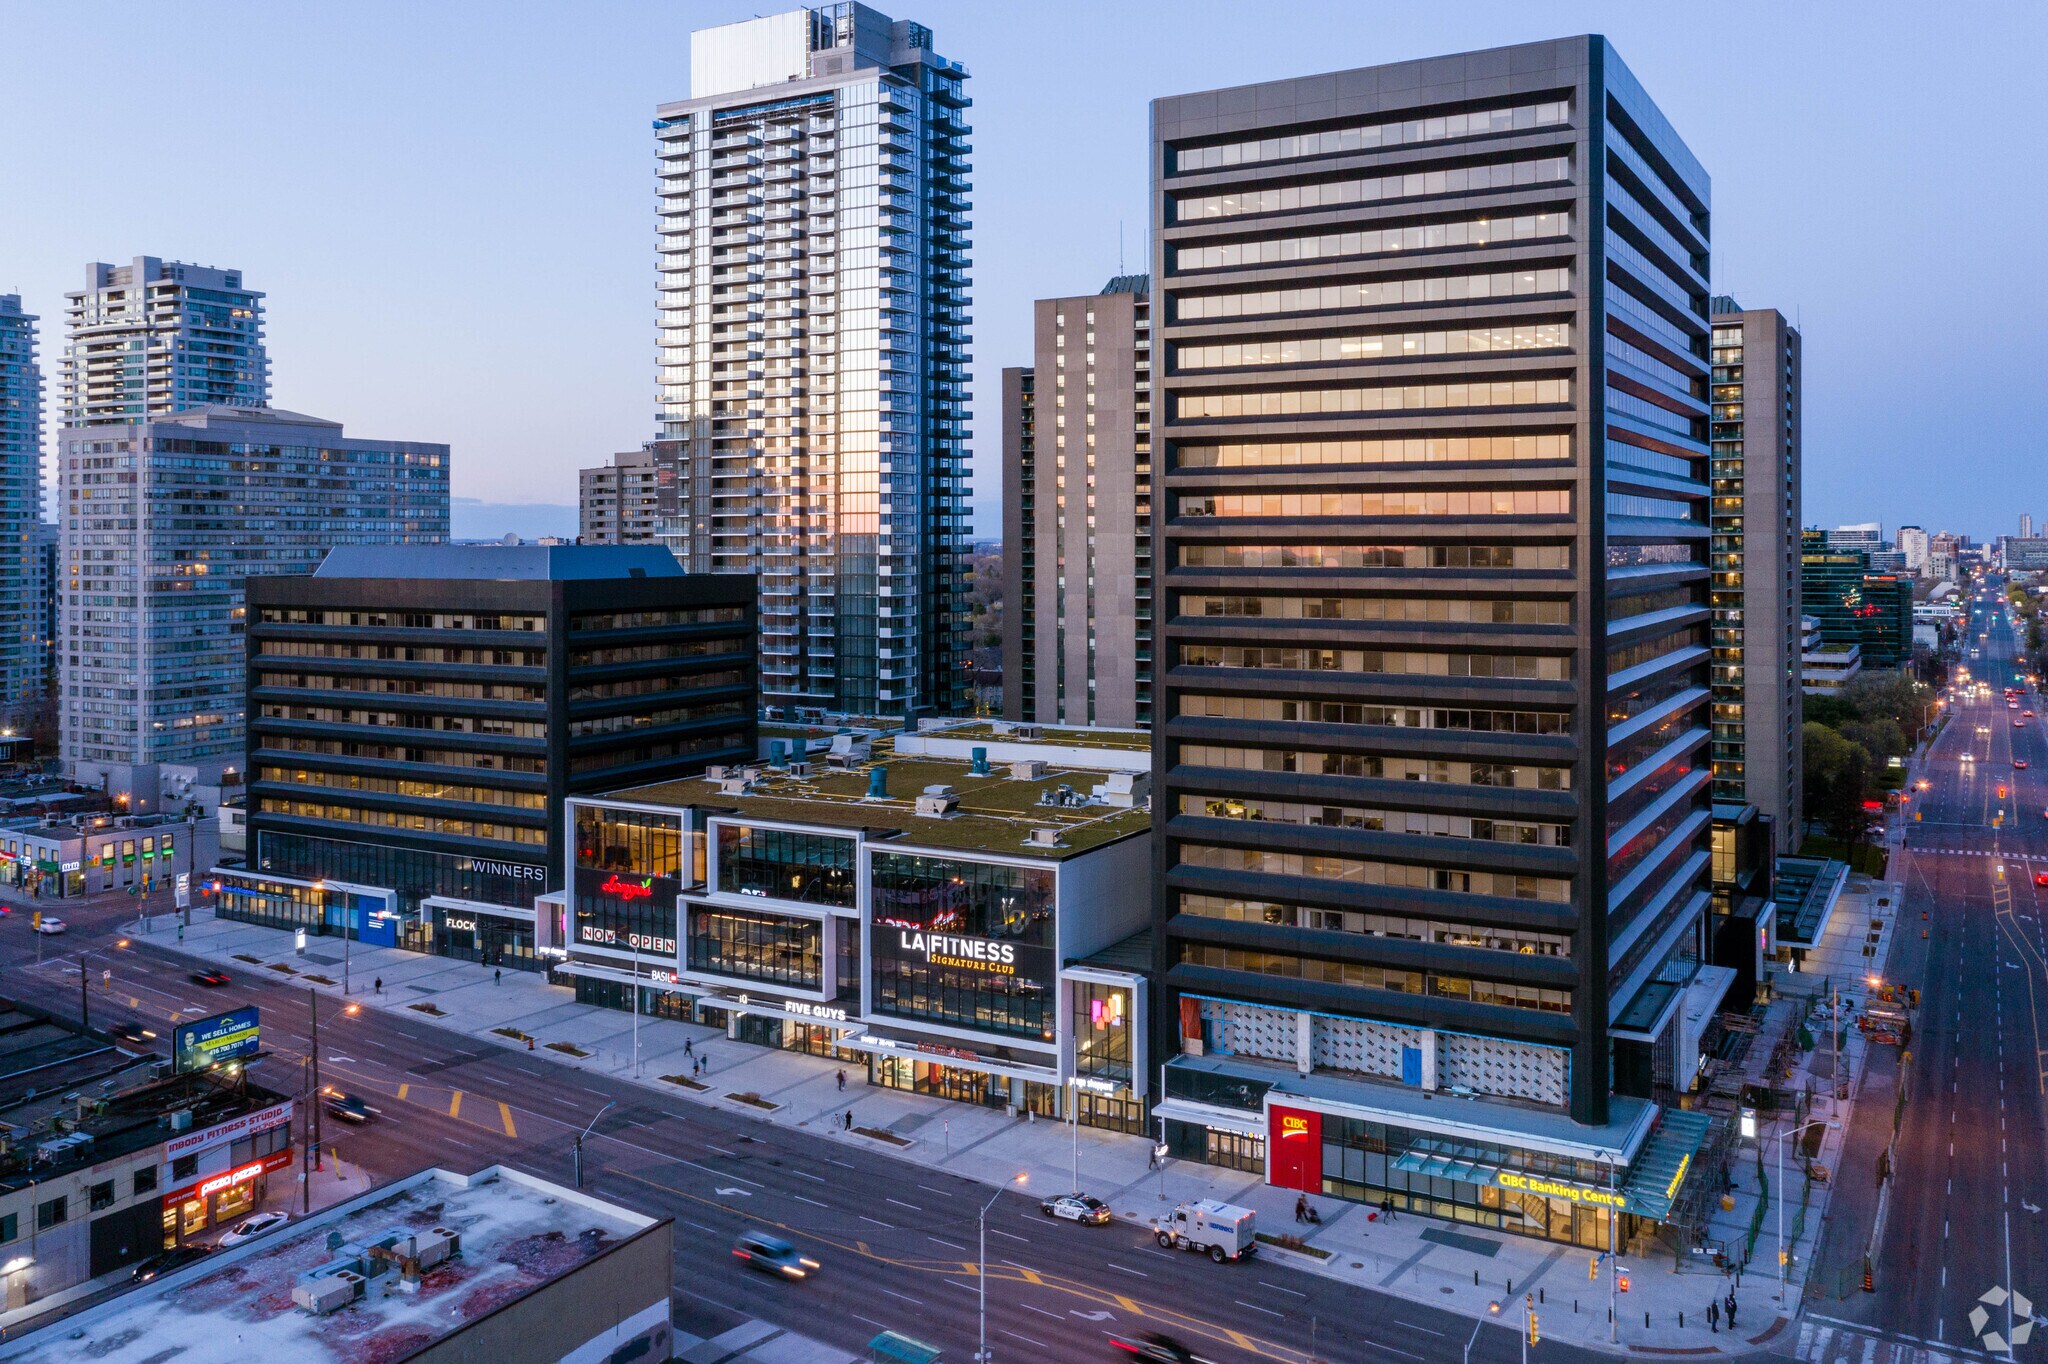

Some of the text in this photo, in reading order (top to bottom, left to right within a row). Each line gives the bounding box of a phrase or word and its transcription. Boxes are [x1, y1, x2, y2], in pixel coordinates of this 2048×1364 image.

[472, 860, 543, 881] WINNERS
[446, 918, 476, 931] FLOCK
[584, 928, 675, 951] NOW OPEN
[901, 931, 1014, 963] LA FITNESS
[931, 954, 1015, 974] SIGNATURE CLUB
[651, 970, 671, 983] BASIL
[785, 1001, 846, 1021] FIVE GUYS
[201, 1032, 211, 1040] WE
[213, 1029, 228, 1037] SELL
[229, 1021, 251, 1032] HOMES
[249, 1108, 283, 1125] STUDIO
[1283, 1117, 1308, 1130] CIBC
[201, 1164, 262, 1197] pizza pizza
[1499, 1173, 1625, 1207] CIBC Banking Centre
[1058, 1208, 1075, 1217] POLICE
